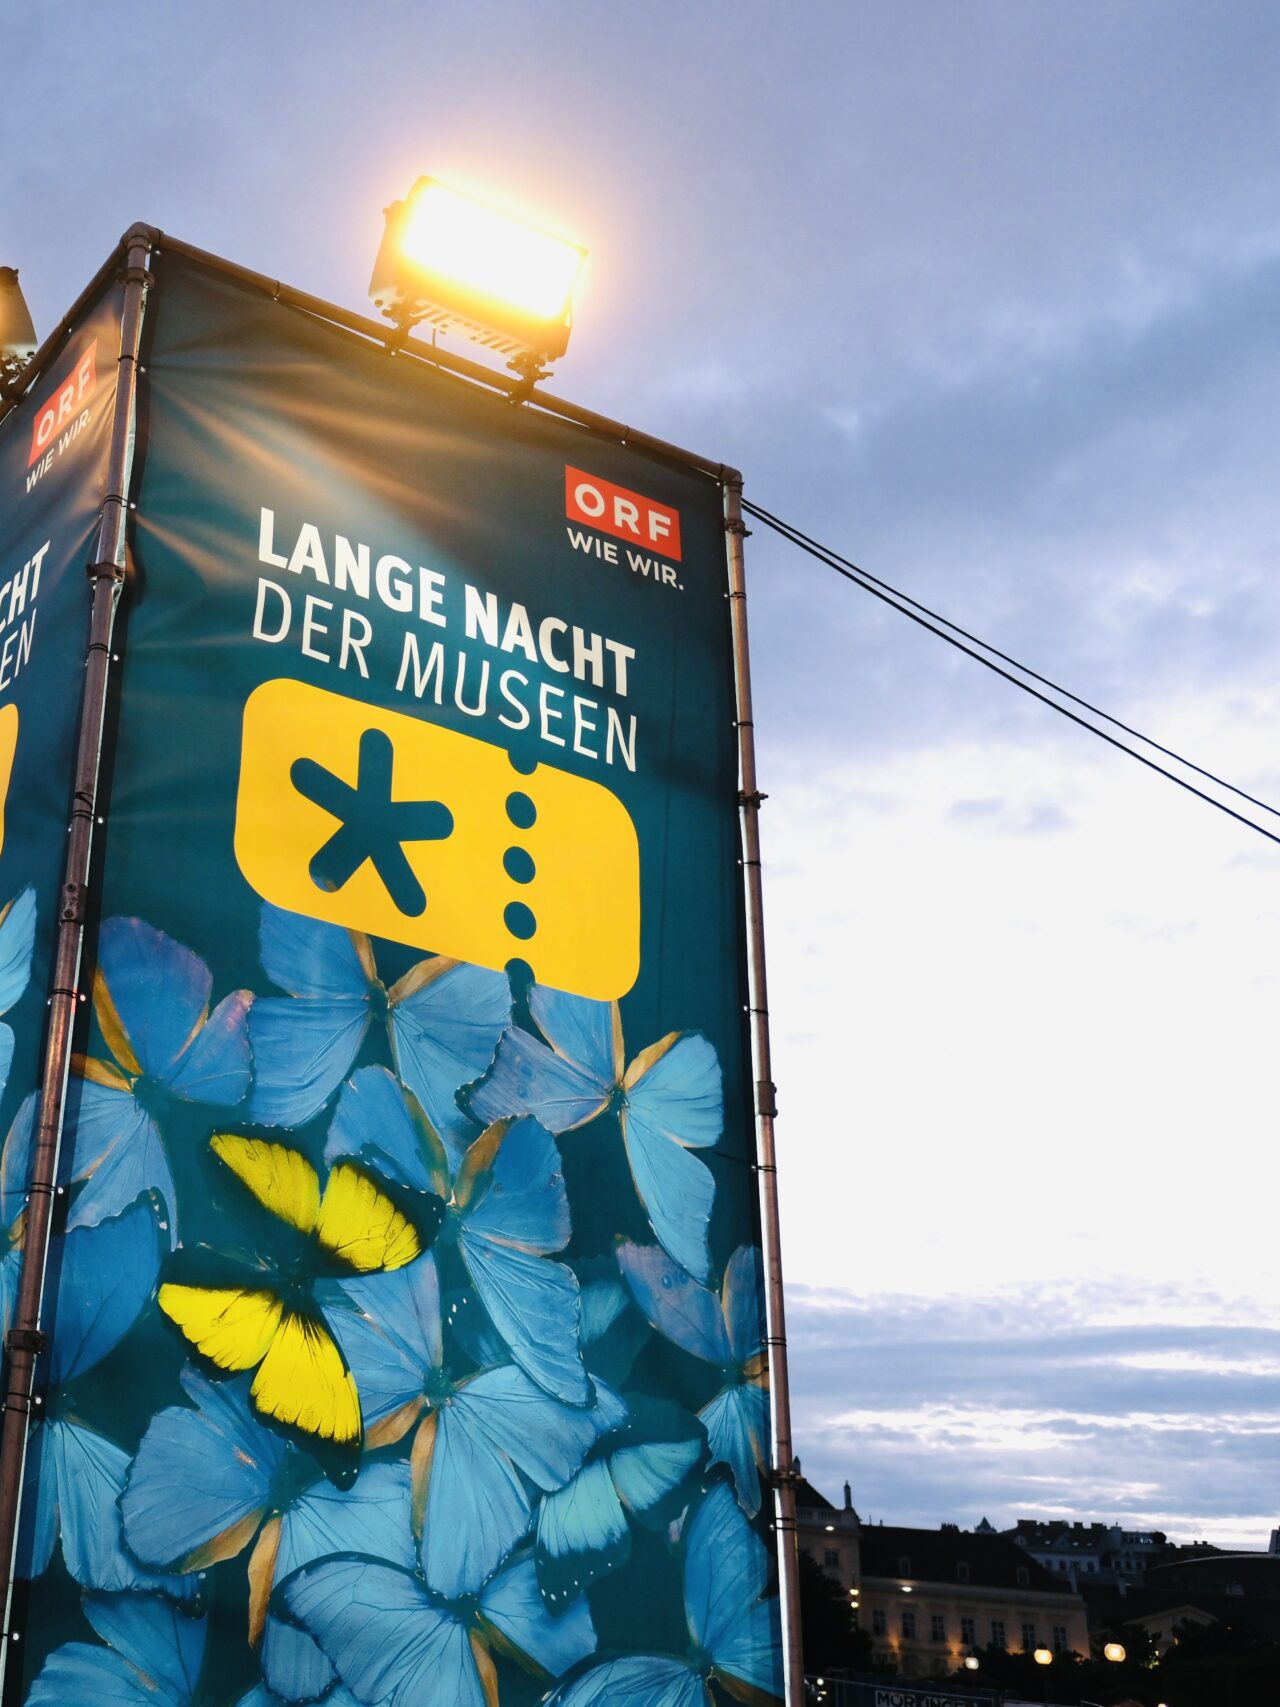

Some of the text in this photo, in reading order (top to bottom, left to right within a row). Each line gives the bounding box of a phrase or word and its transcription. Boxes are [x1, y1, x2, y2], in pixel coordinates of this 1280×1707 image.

[36, 357, 91, 446] ORF
[26, 408, 92, 494] WIE WIR.
[574, 483, 671, 542] ORF
[258, 506, 636, 697] LANGE NACHT
[566, 527, 684, 590] WIE WIR.
[252, 577, 637, 772] DER MUSEEN
